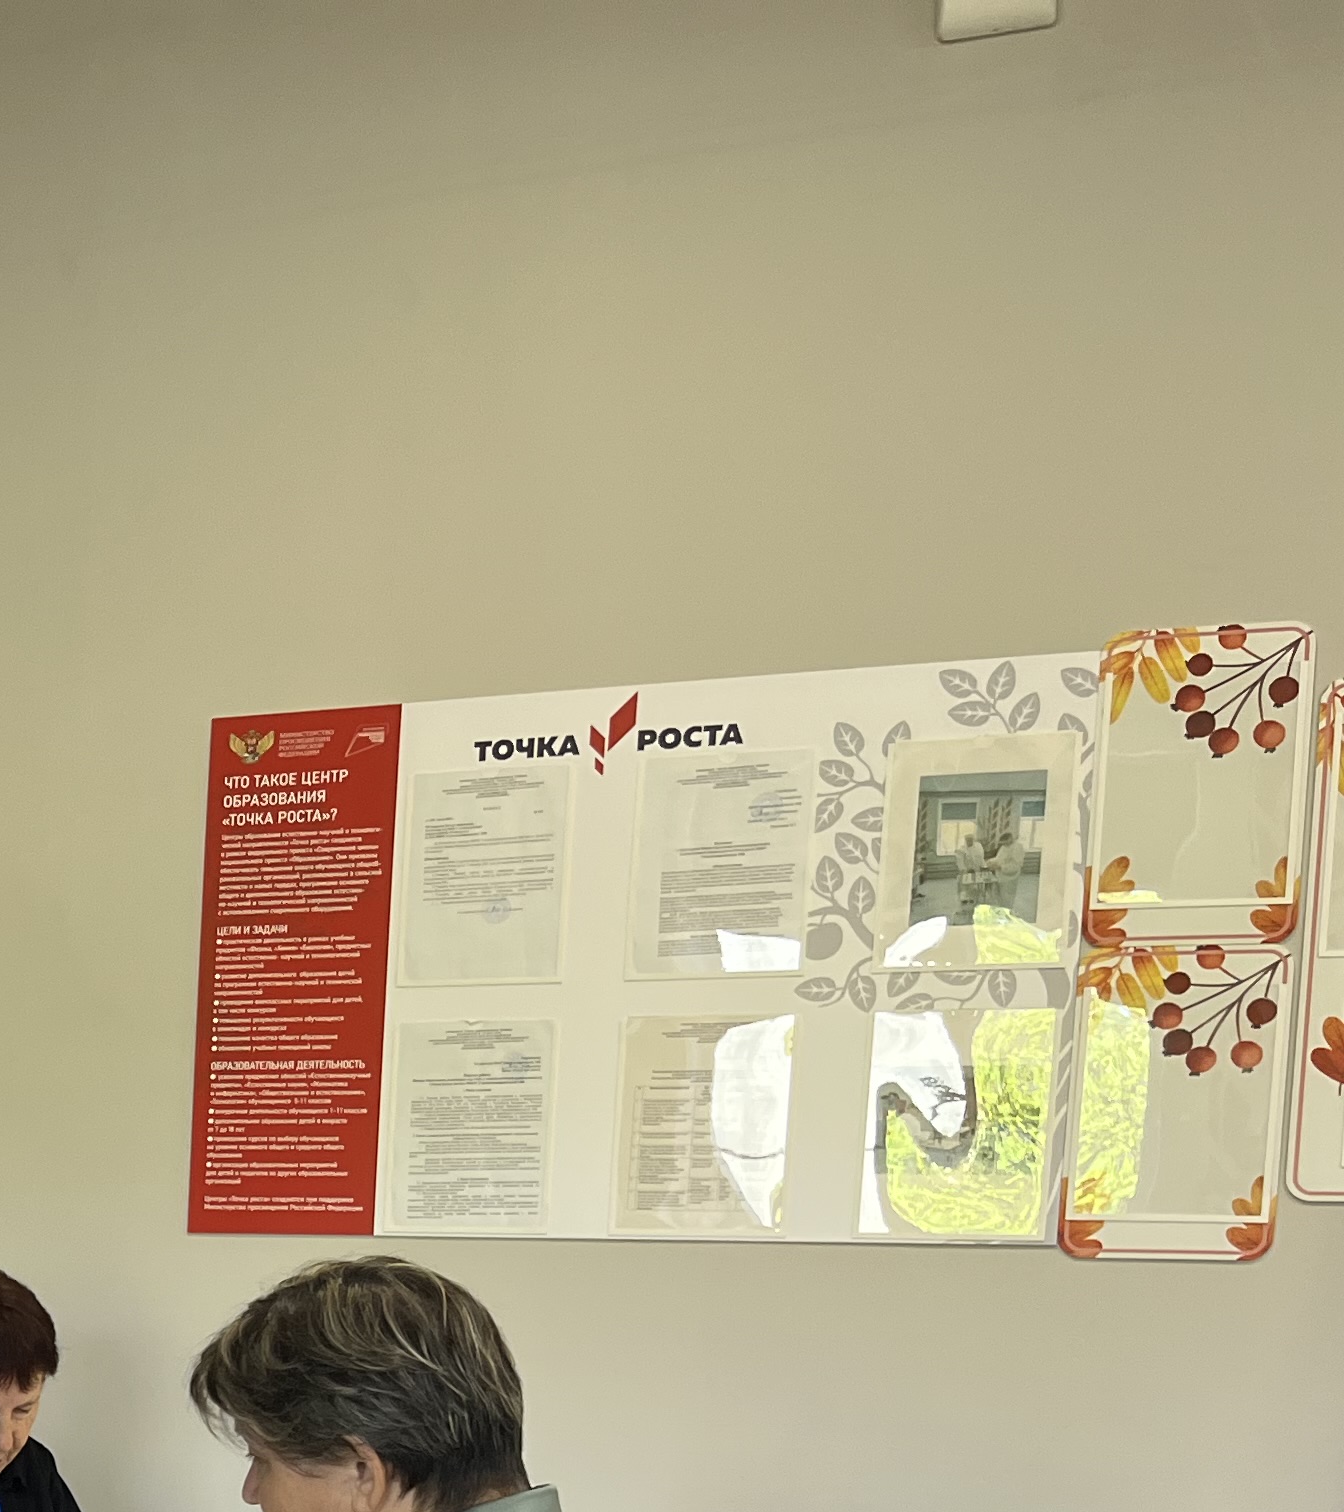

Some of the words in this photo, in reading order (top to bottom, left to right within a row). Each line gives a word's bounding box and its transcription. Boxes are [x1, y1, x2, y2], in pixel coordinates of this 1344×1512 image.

[473, 734, 581, 763] ТОЧКА
[637, 723, 744, 752] РОСТА
[224, 774, 250, 790] ЧТО
[254, 771, 298, 788] ТАКОЕ
[301, 768, 349, 787] ЦЕНТР
[222, 789, 327, 809] ОБРАЗОВАНИЯ
[221, 812, 274, 827] «ТОЧКА
[277, 807, 338, 825] РОСТА»?
[216, 925, 242, 937] ЦЕЛИ
[243, 925, 251, 935] И
[252, 924, 288, 936] ЗАДАЧИ
[210, 1060, 295, 1071] ОБРАЗОВАТЕЛЬНАЯ
[296, 1059, 366, 1071] ДЕЯТЕЛЬНОСТЬ
